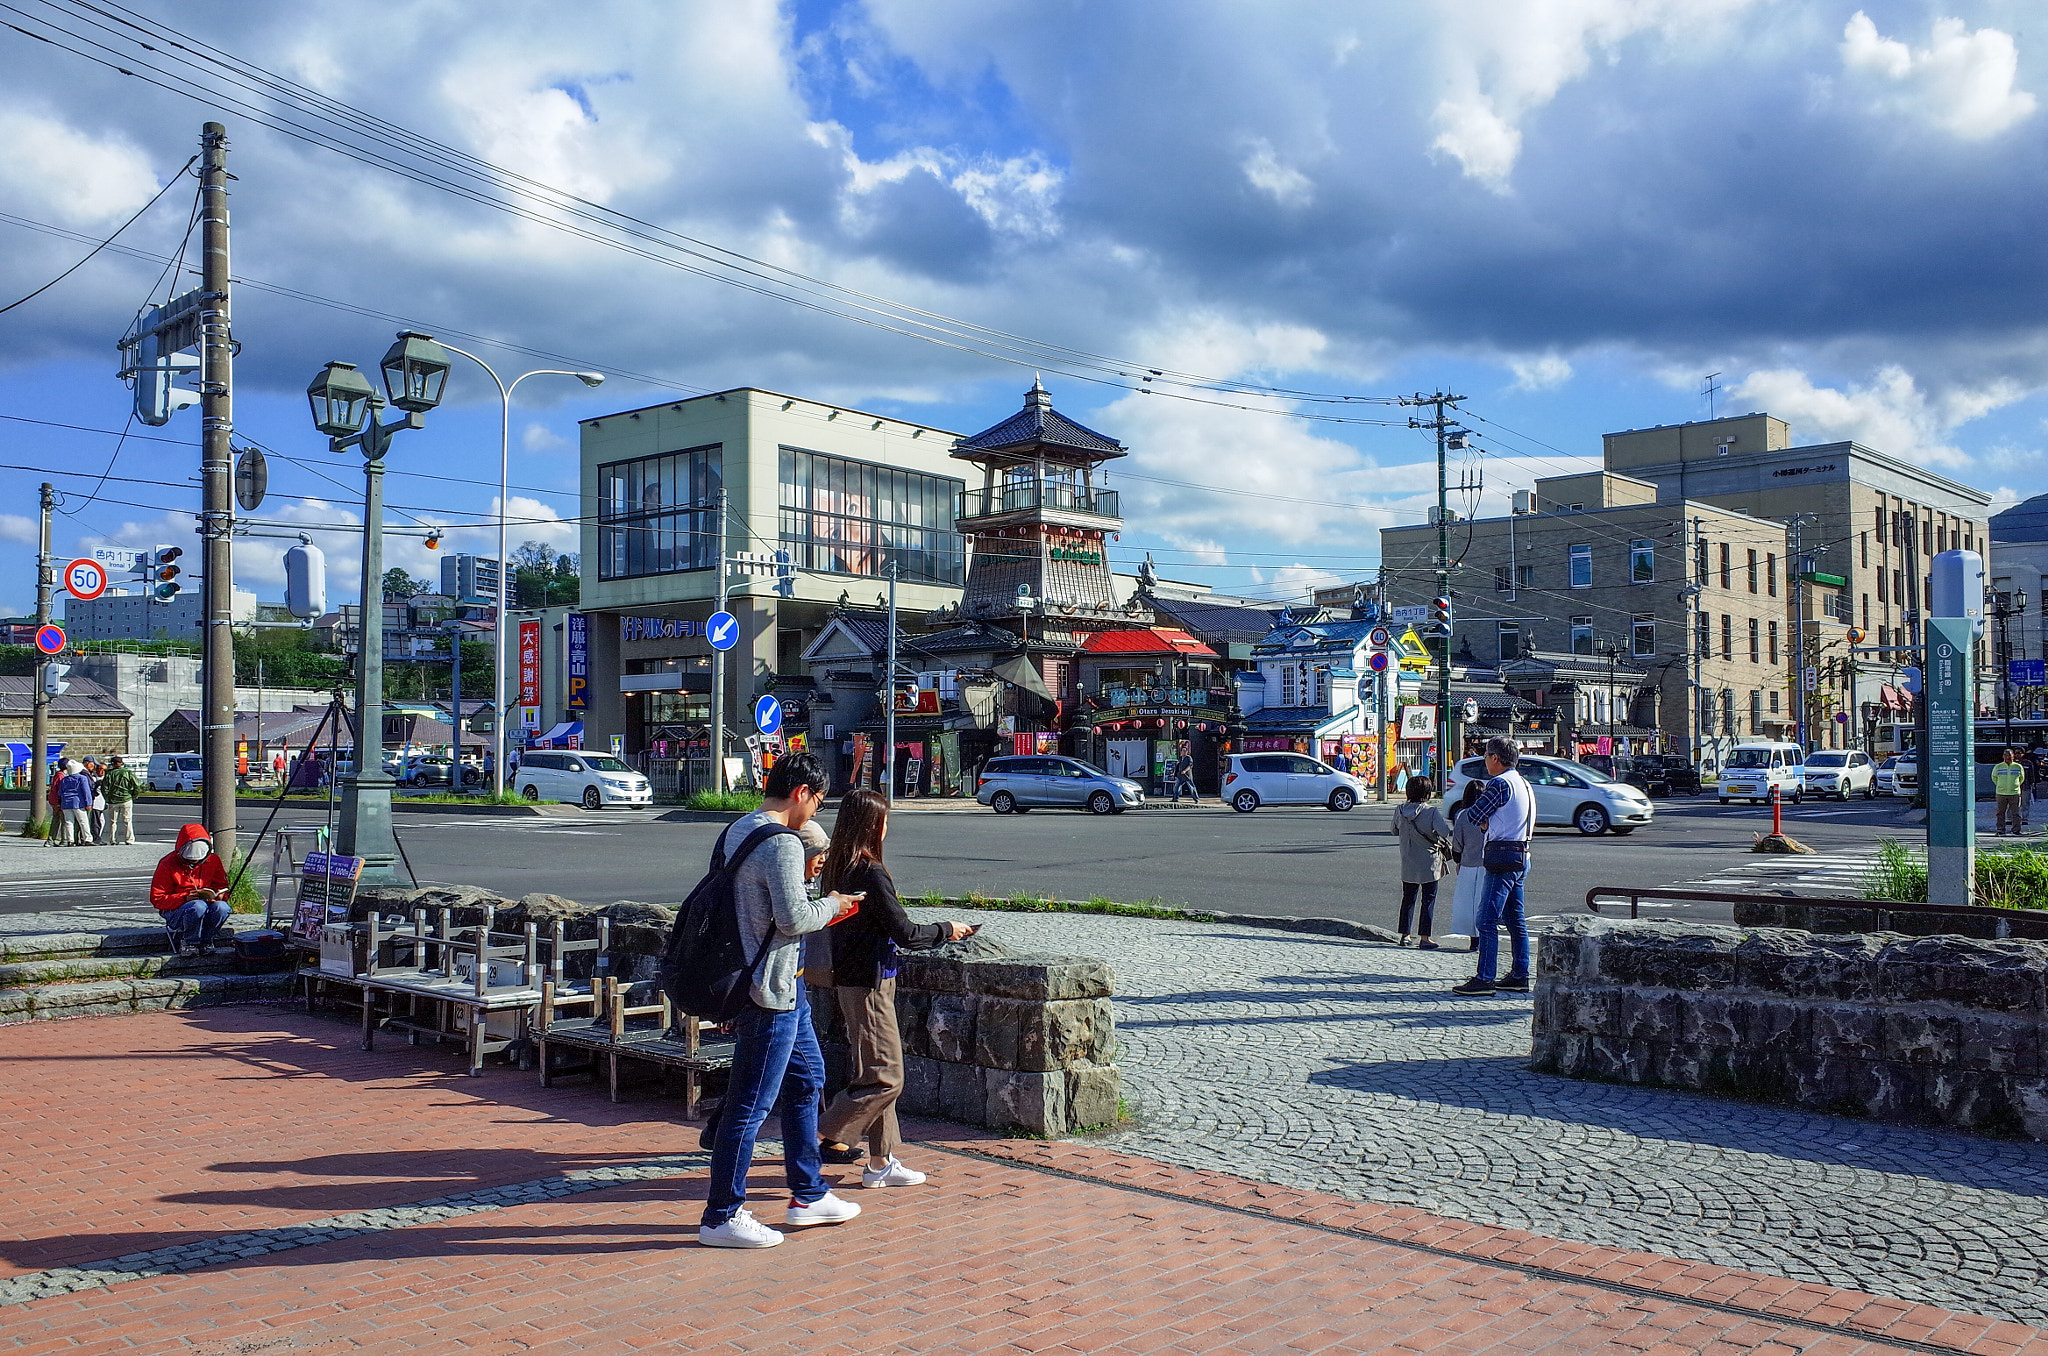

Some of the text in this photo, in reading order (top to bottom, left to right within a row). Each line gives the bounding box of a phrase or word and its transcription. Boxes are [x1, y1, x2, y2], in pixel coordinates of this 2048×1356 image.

[74, 569, 97, 589] 50
[571, 617, 586, 676] 洋服の青山
[1374, 632, 1385, 641] 40
[522, 629, 534, 702] 大感謝祭
[571, 677, 586, 696] P
